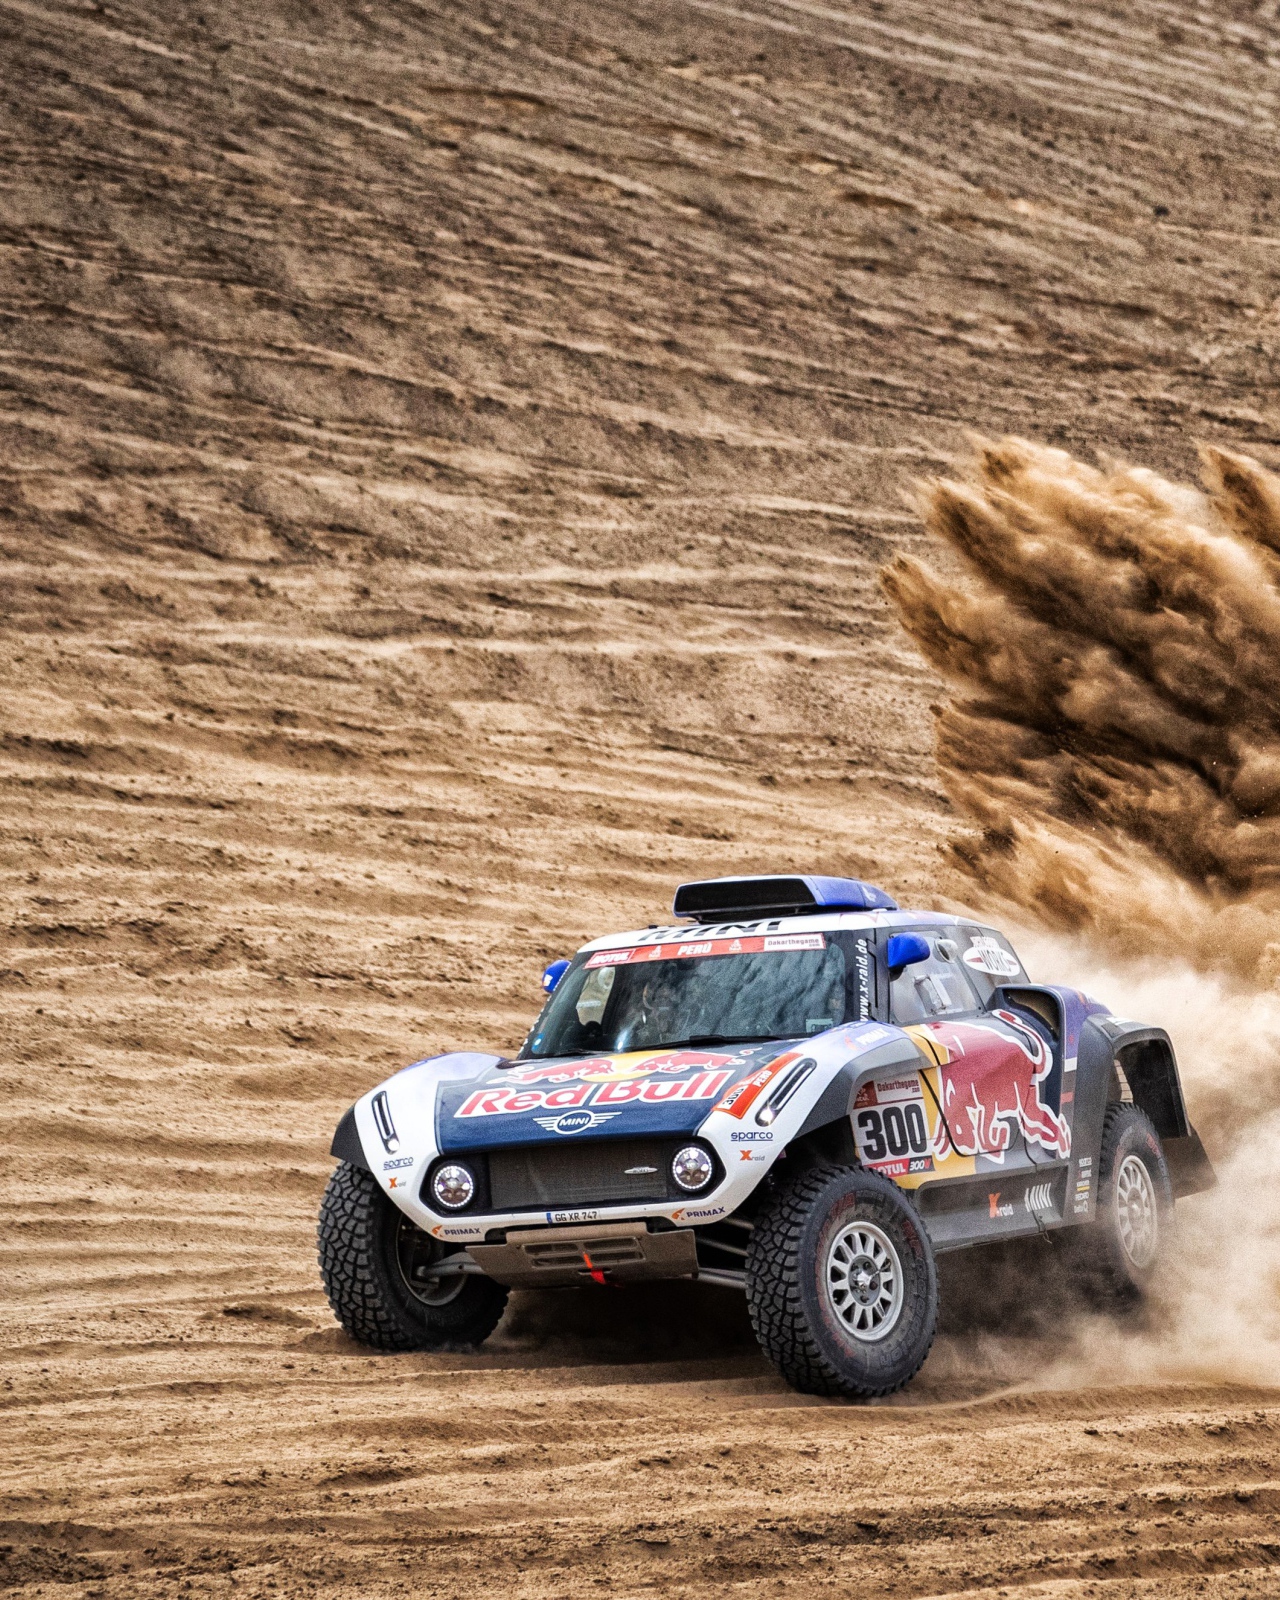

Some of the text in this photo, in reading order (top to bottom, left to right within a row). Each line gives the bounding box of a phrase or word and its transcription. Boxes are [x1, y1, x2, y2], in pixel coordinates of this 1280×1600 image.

[637, 920, 782, 942] MINI
[767, 938, 820, 946] Dakarthegame
[589, 951, 631, 965] MOTUL
[877, 1079, 919, 1092] Dakarthegame
[455, 1083, 593, 1117] Red
[591, 1070, 734, 1106] Bull
[722, 1088, 744, 1105] 300
[559, 1117, 589, 1126] MINI
[731, 1131, 774, 1142] sparco
[857, 1103, 928, 1160] 300
[383, 1156, 414, 1171] sparco
[870, 1157, 932, 1176] OTUL 300V
[1024, 1182, 1053, 1213] MINI
[554, 1210, 598, 1222] GG XR 747
[686, 1206, 726, 1218] PRIMAX
[444, 1227, 482, 1236] PRIMAX
